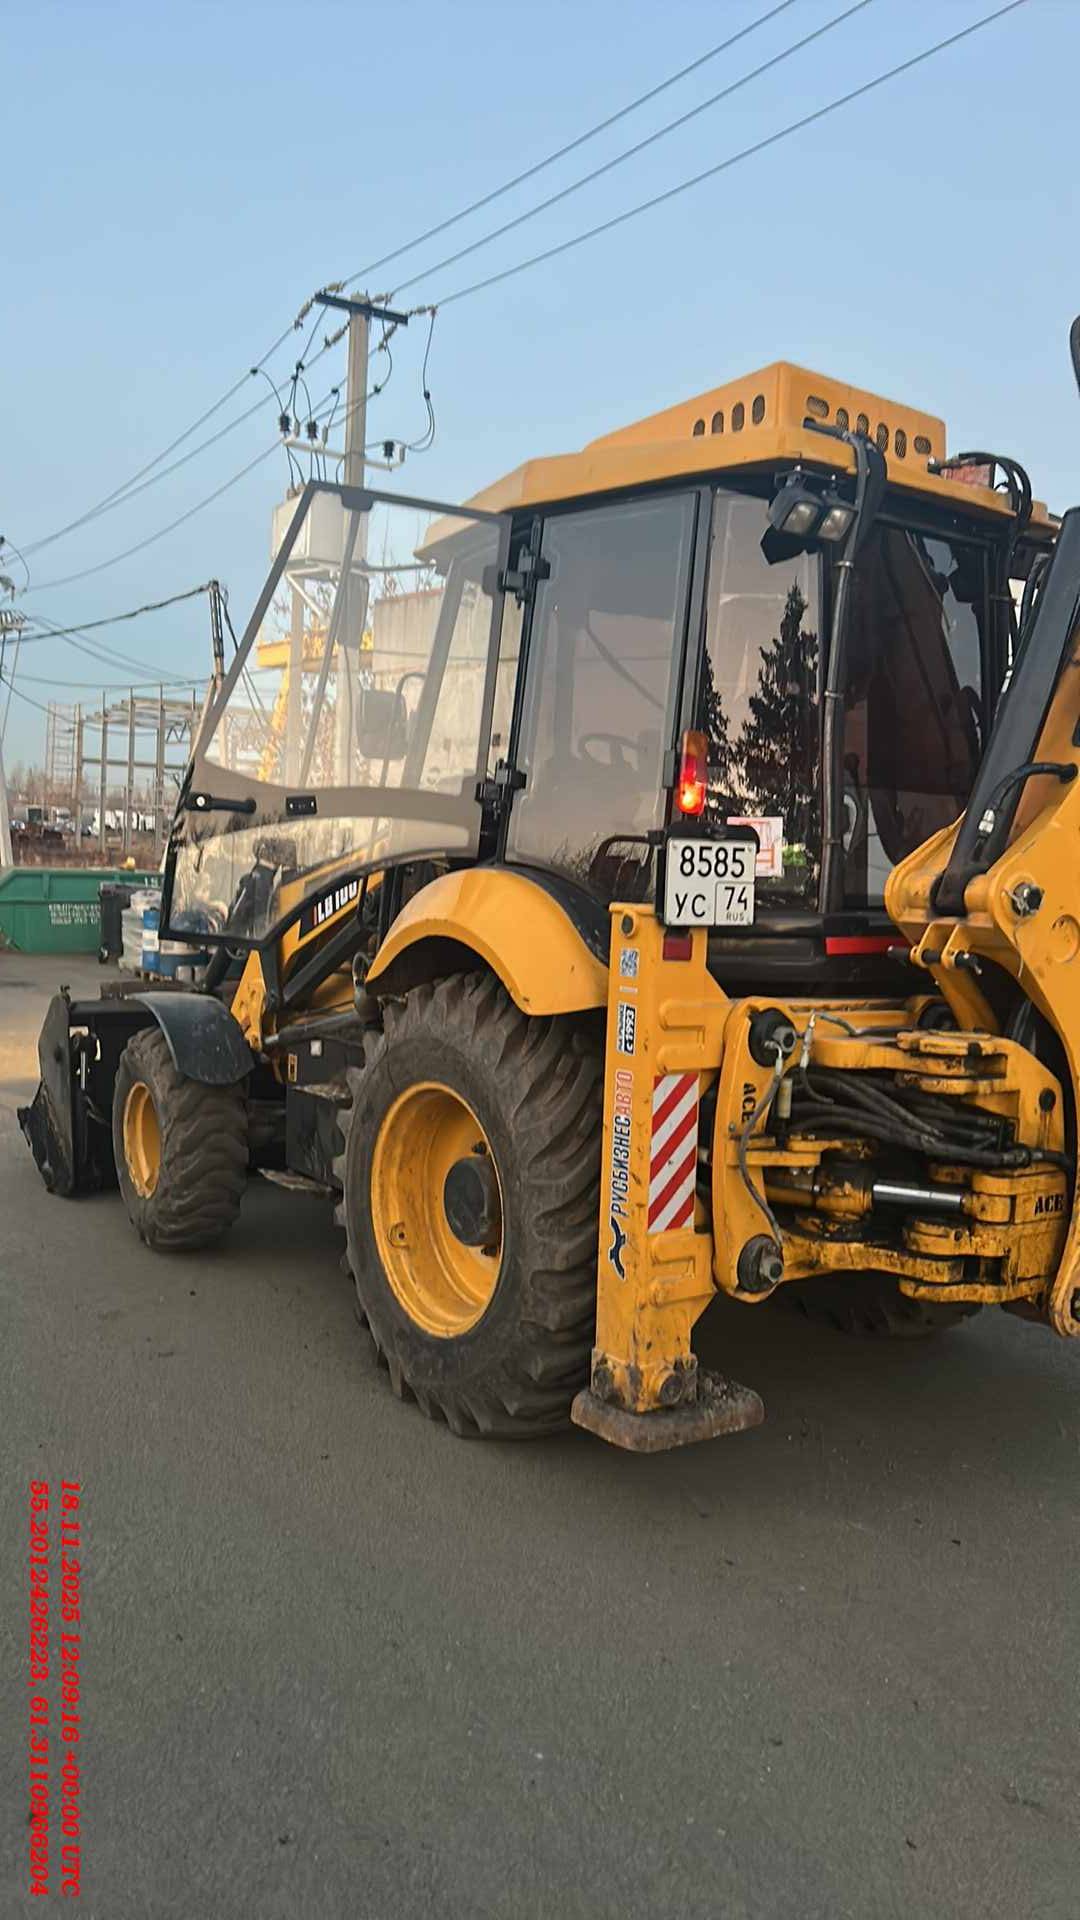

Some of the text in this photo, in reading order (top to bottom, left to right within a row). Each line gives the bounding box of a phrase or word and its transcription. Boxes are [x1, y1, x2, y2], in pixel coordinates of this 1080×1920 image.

[680, 845, 745, 877] 8585
[675, 886, 748, 918] УС 74
[726, 911, 745, 921] RUS
[742, 1083, 757, 1123] ACE
[611, 1071, 633, 1217] РУСБИЗНЕСАВТО
[1034, 1193, 1064, 1216] ACE
